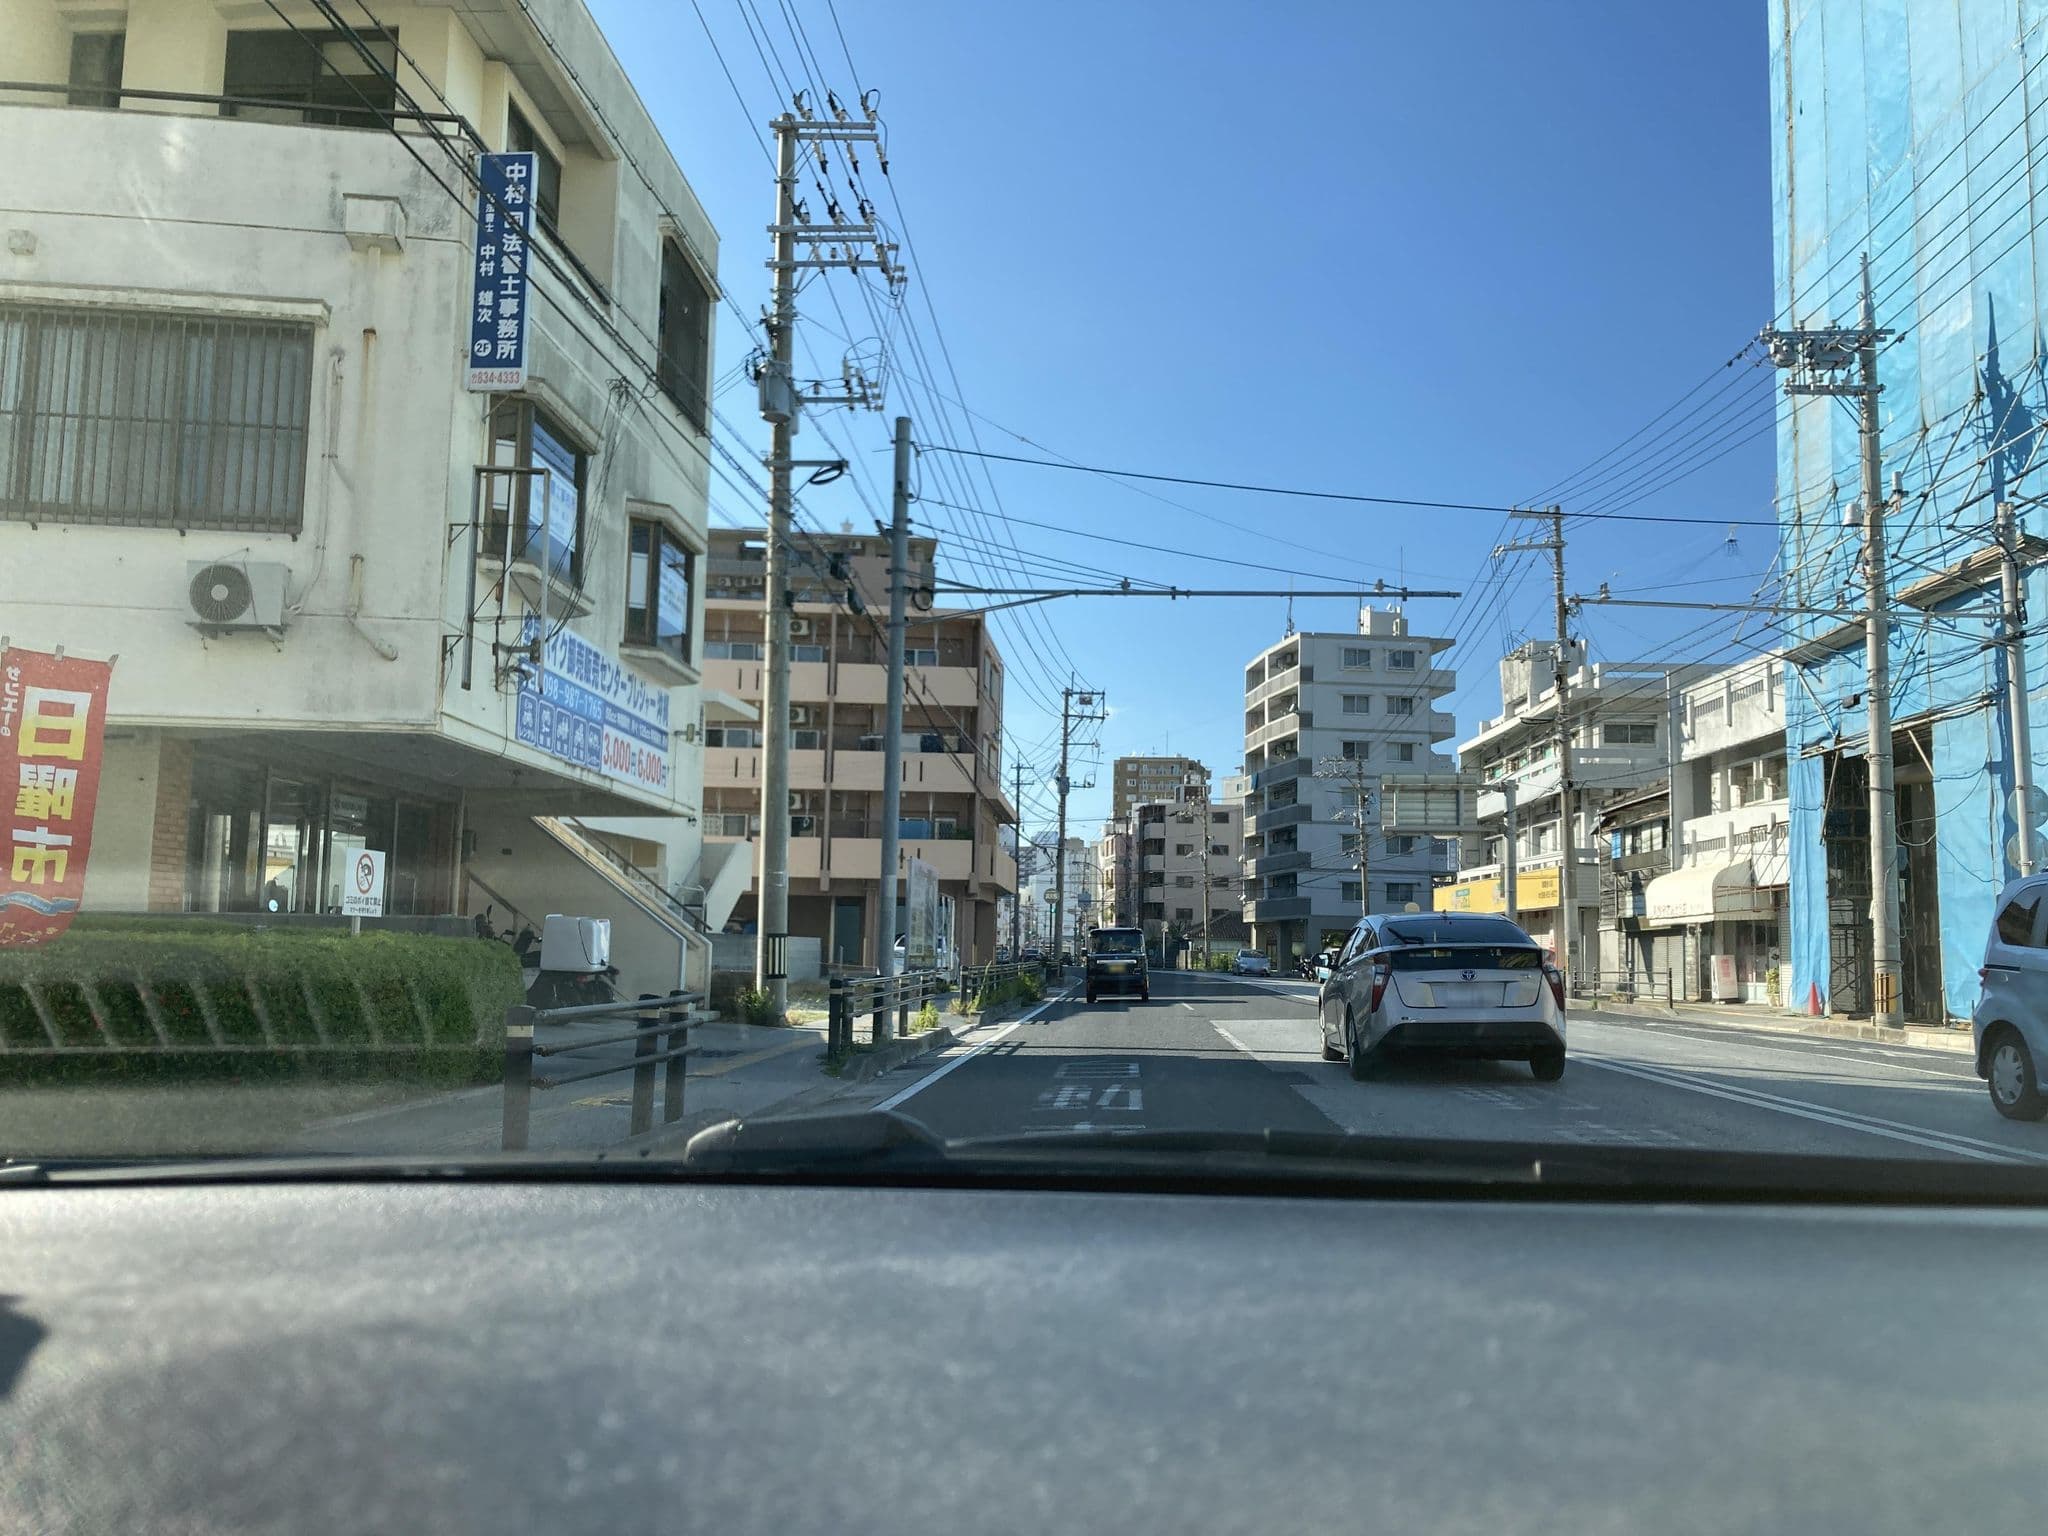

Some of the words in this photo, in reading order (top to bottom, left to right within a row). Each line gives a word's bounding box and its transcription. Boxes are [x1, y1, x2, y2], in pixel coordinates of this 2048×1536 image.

[479, 243, 496, 277] 中村
[475, 340, 492, 356] 2F
[543, 676, 602, 721] 098-987-1765
